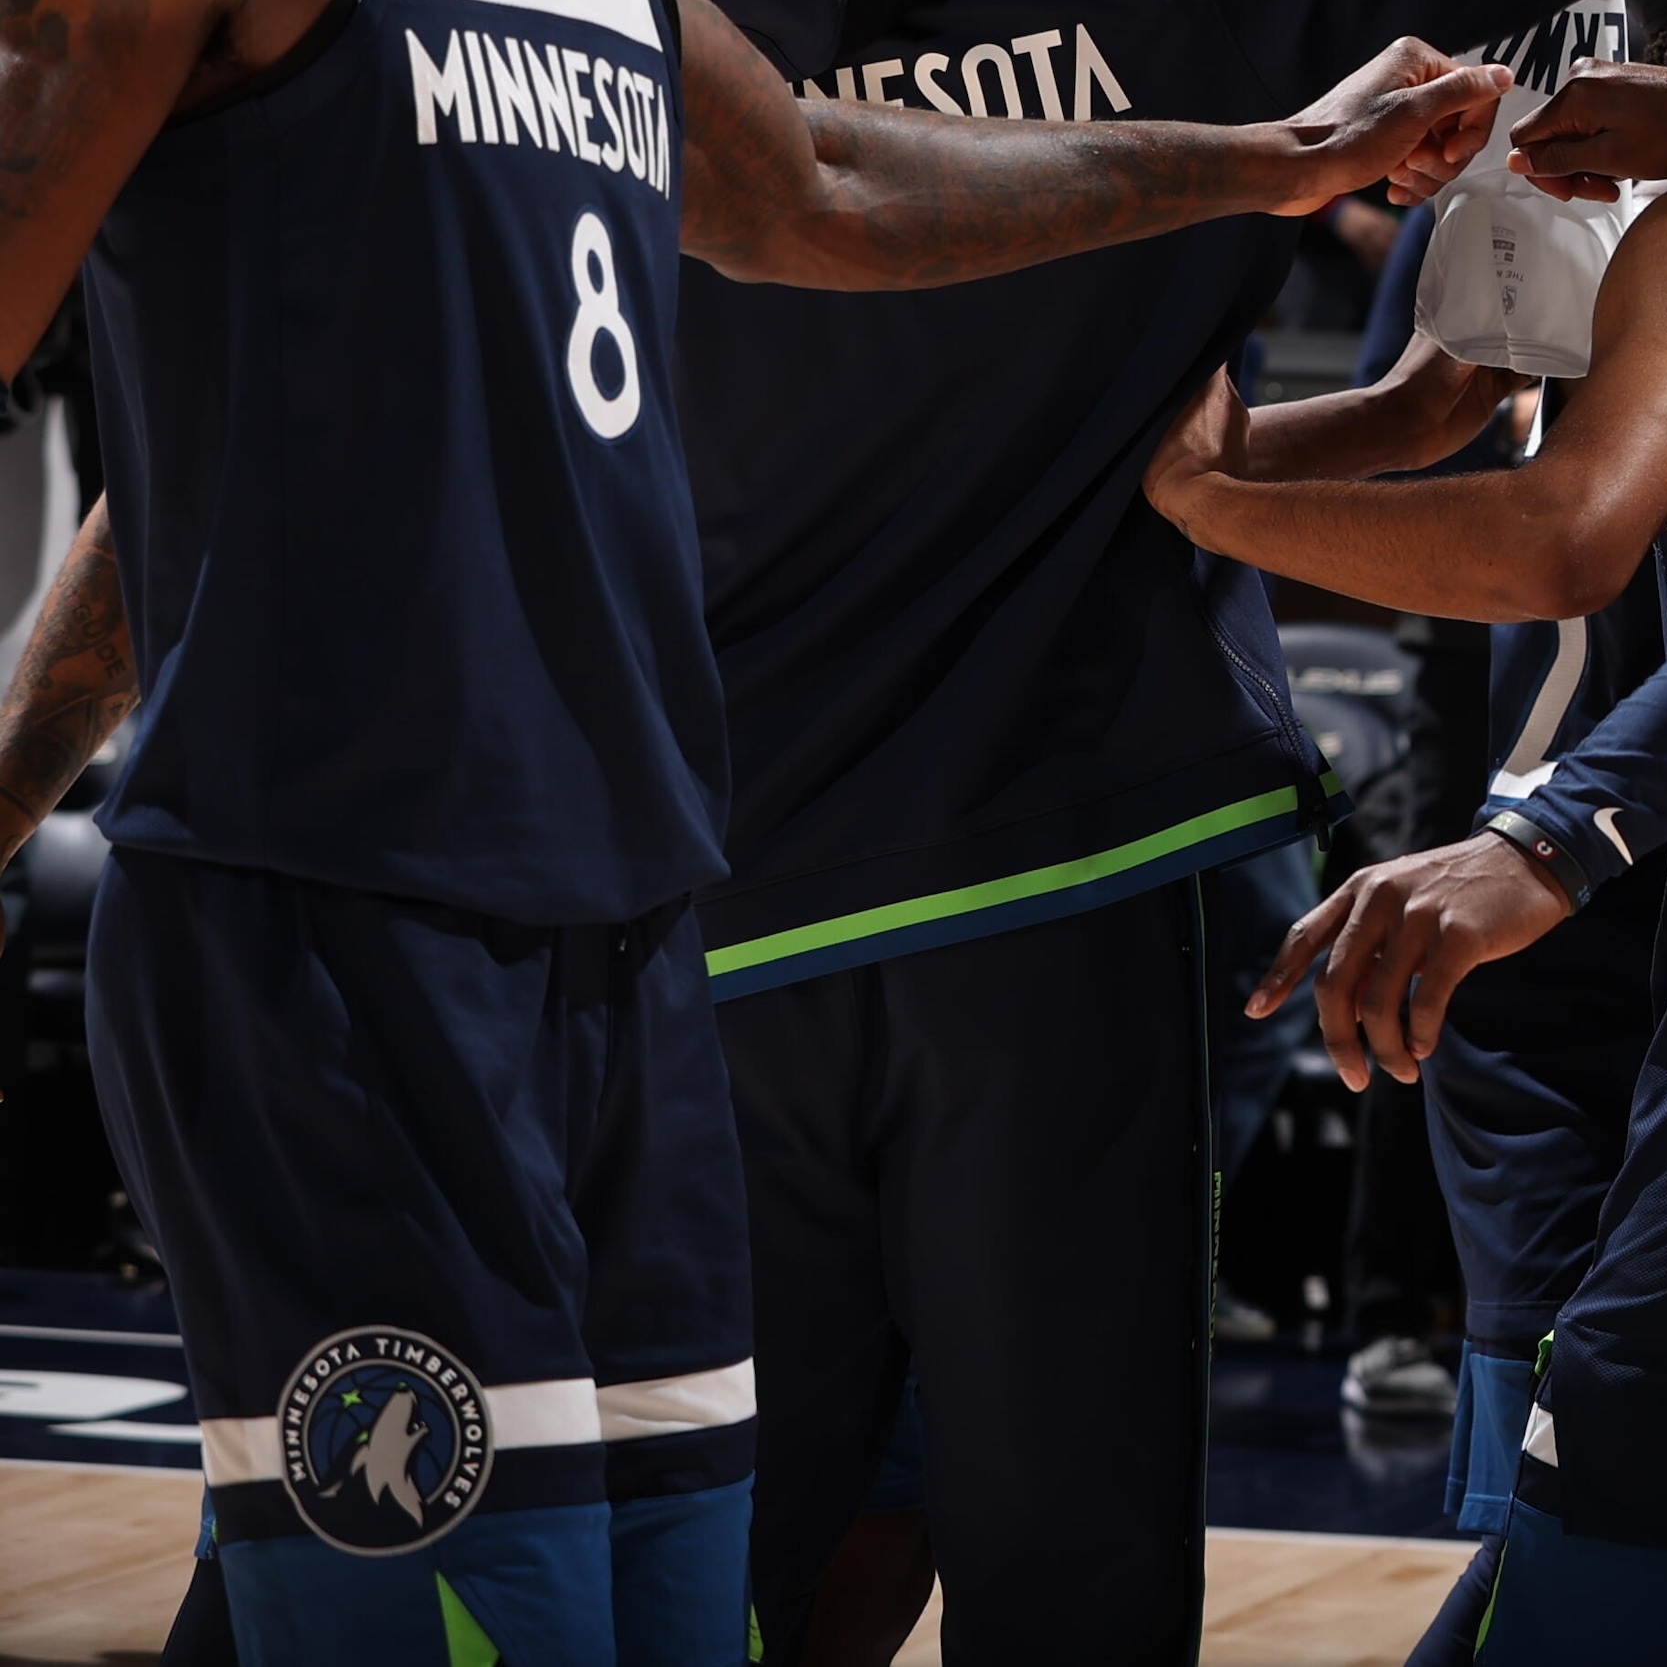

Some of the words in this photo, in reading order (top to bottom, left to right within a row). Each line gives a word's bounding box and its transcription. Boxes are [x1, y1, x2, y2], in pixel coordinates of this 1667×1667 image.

[405, 28, 671, 201] MINNESOTA
[566, 211, 642, 440] 8
[285, 1342, 362, 1483] MINNESOTA
[374, 1337, 484, 1510] TIMBERWOLVES
